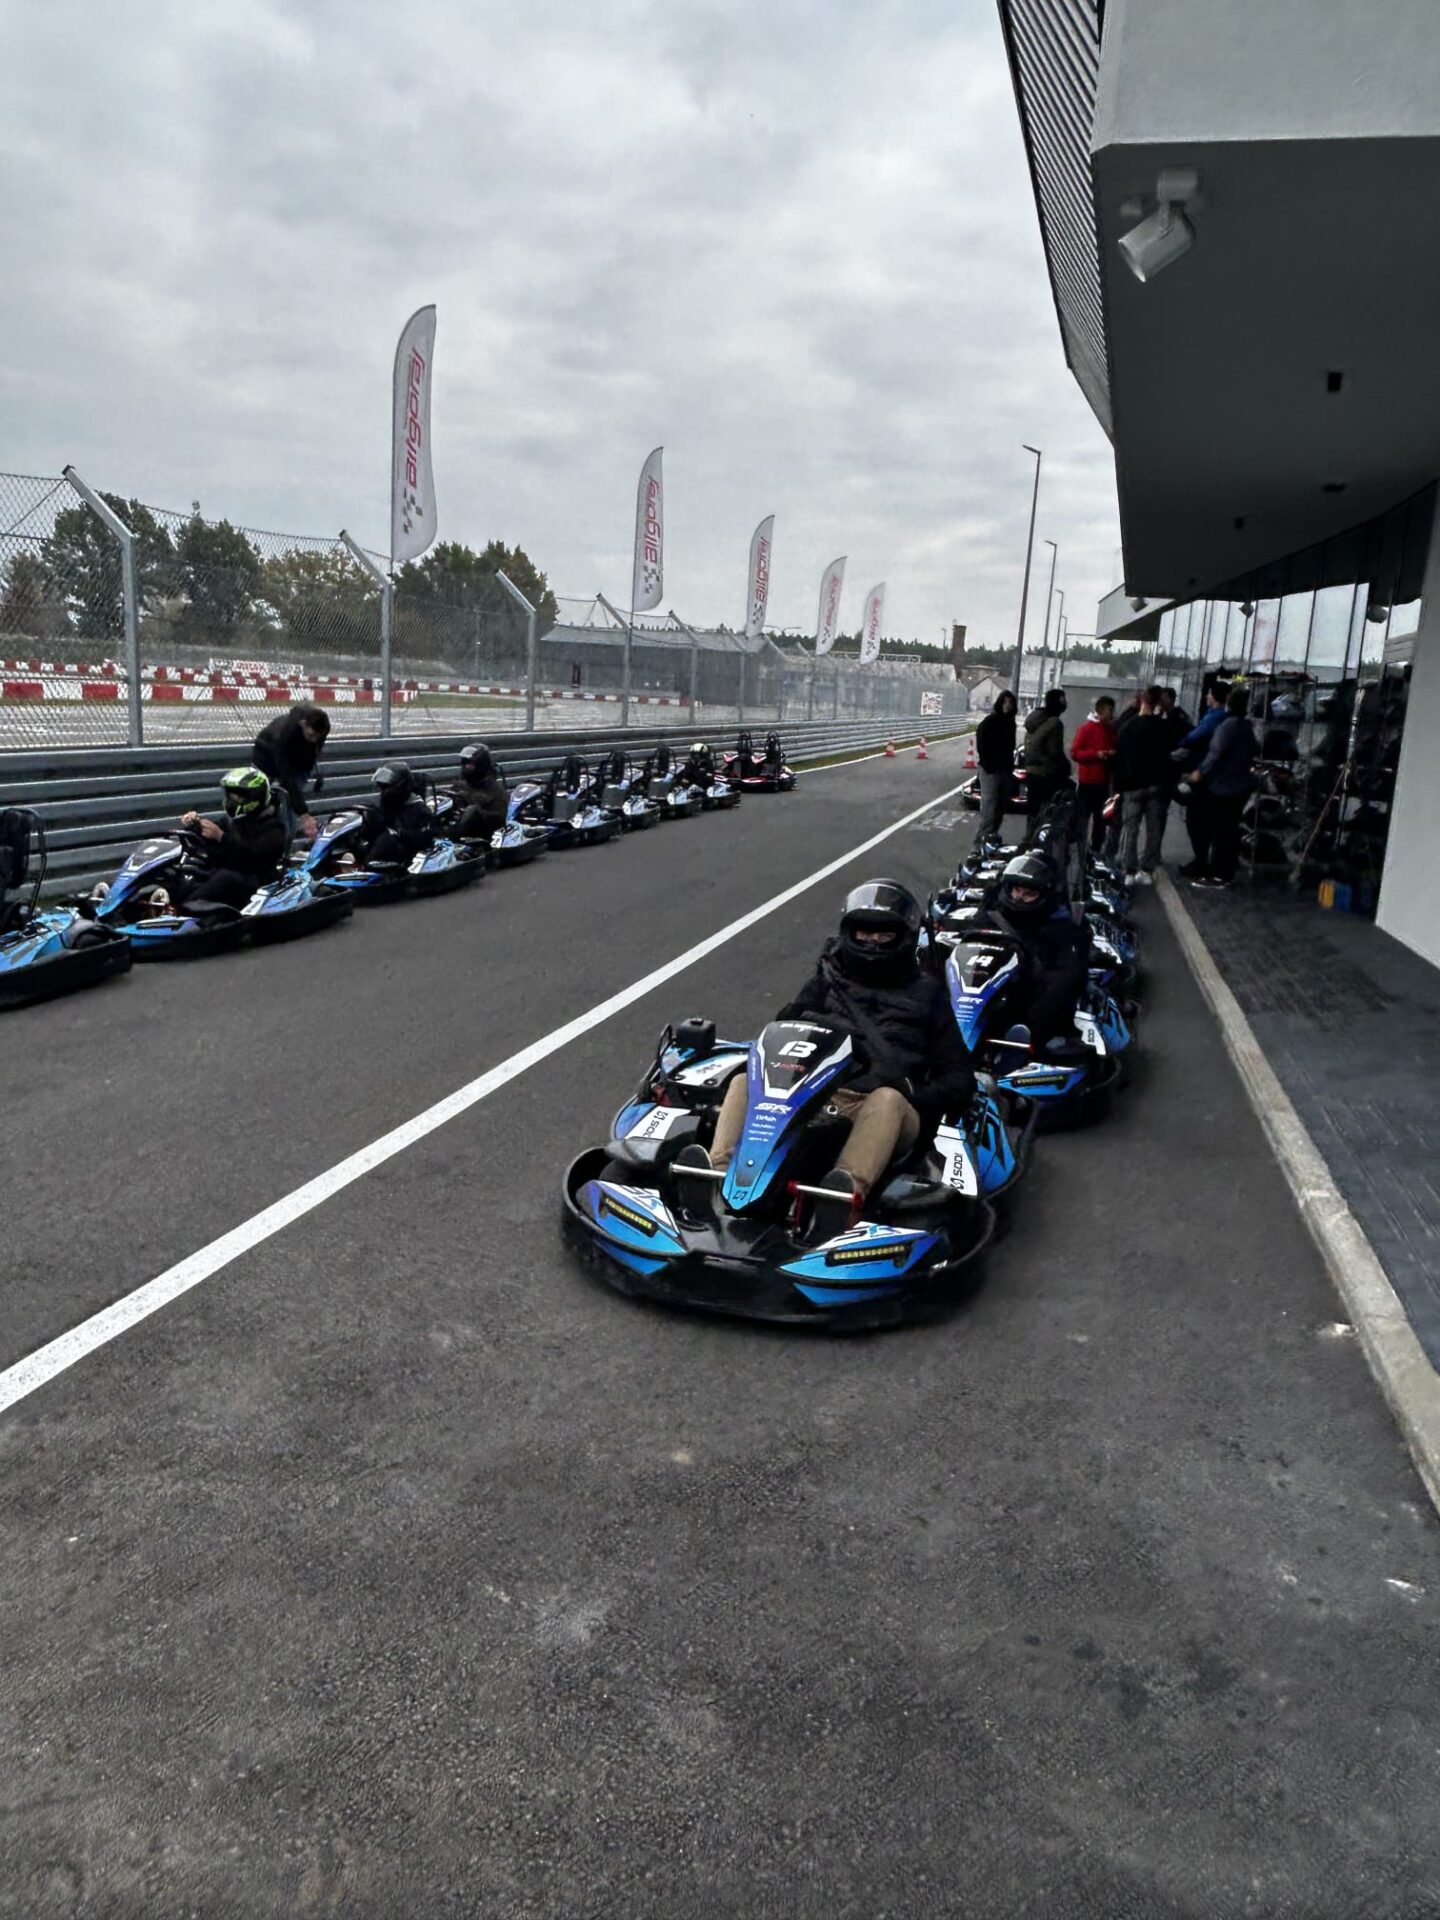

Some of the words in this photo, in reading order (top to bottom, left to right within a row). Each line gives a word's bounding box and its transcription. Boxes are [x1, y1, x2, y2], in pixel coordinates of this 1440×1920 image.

[966, 955, 994, 967] 14
[778, 1040, 818, 1059] 13
[952, 1152, 963, 1177] SODI
